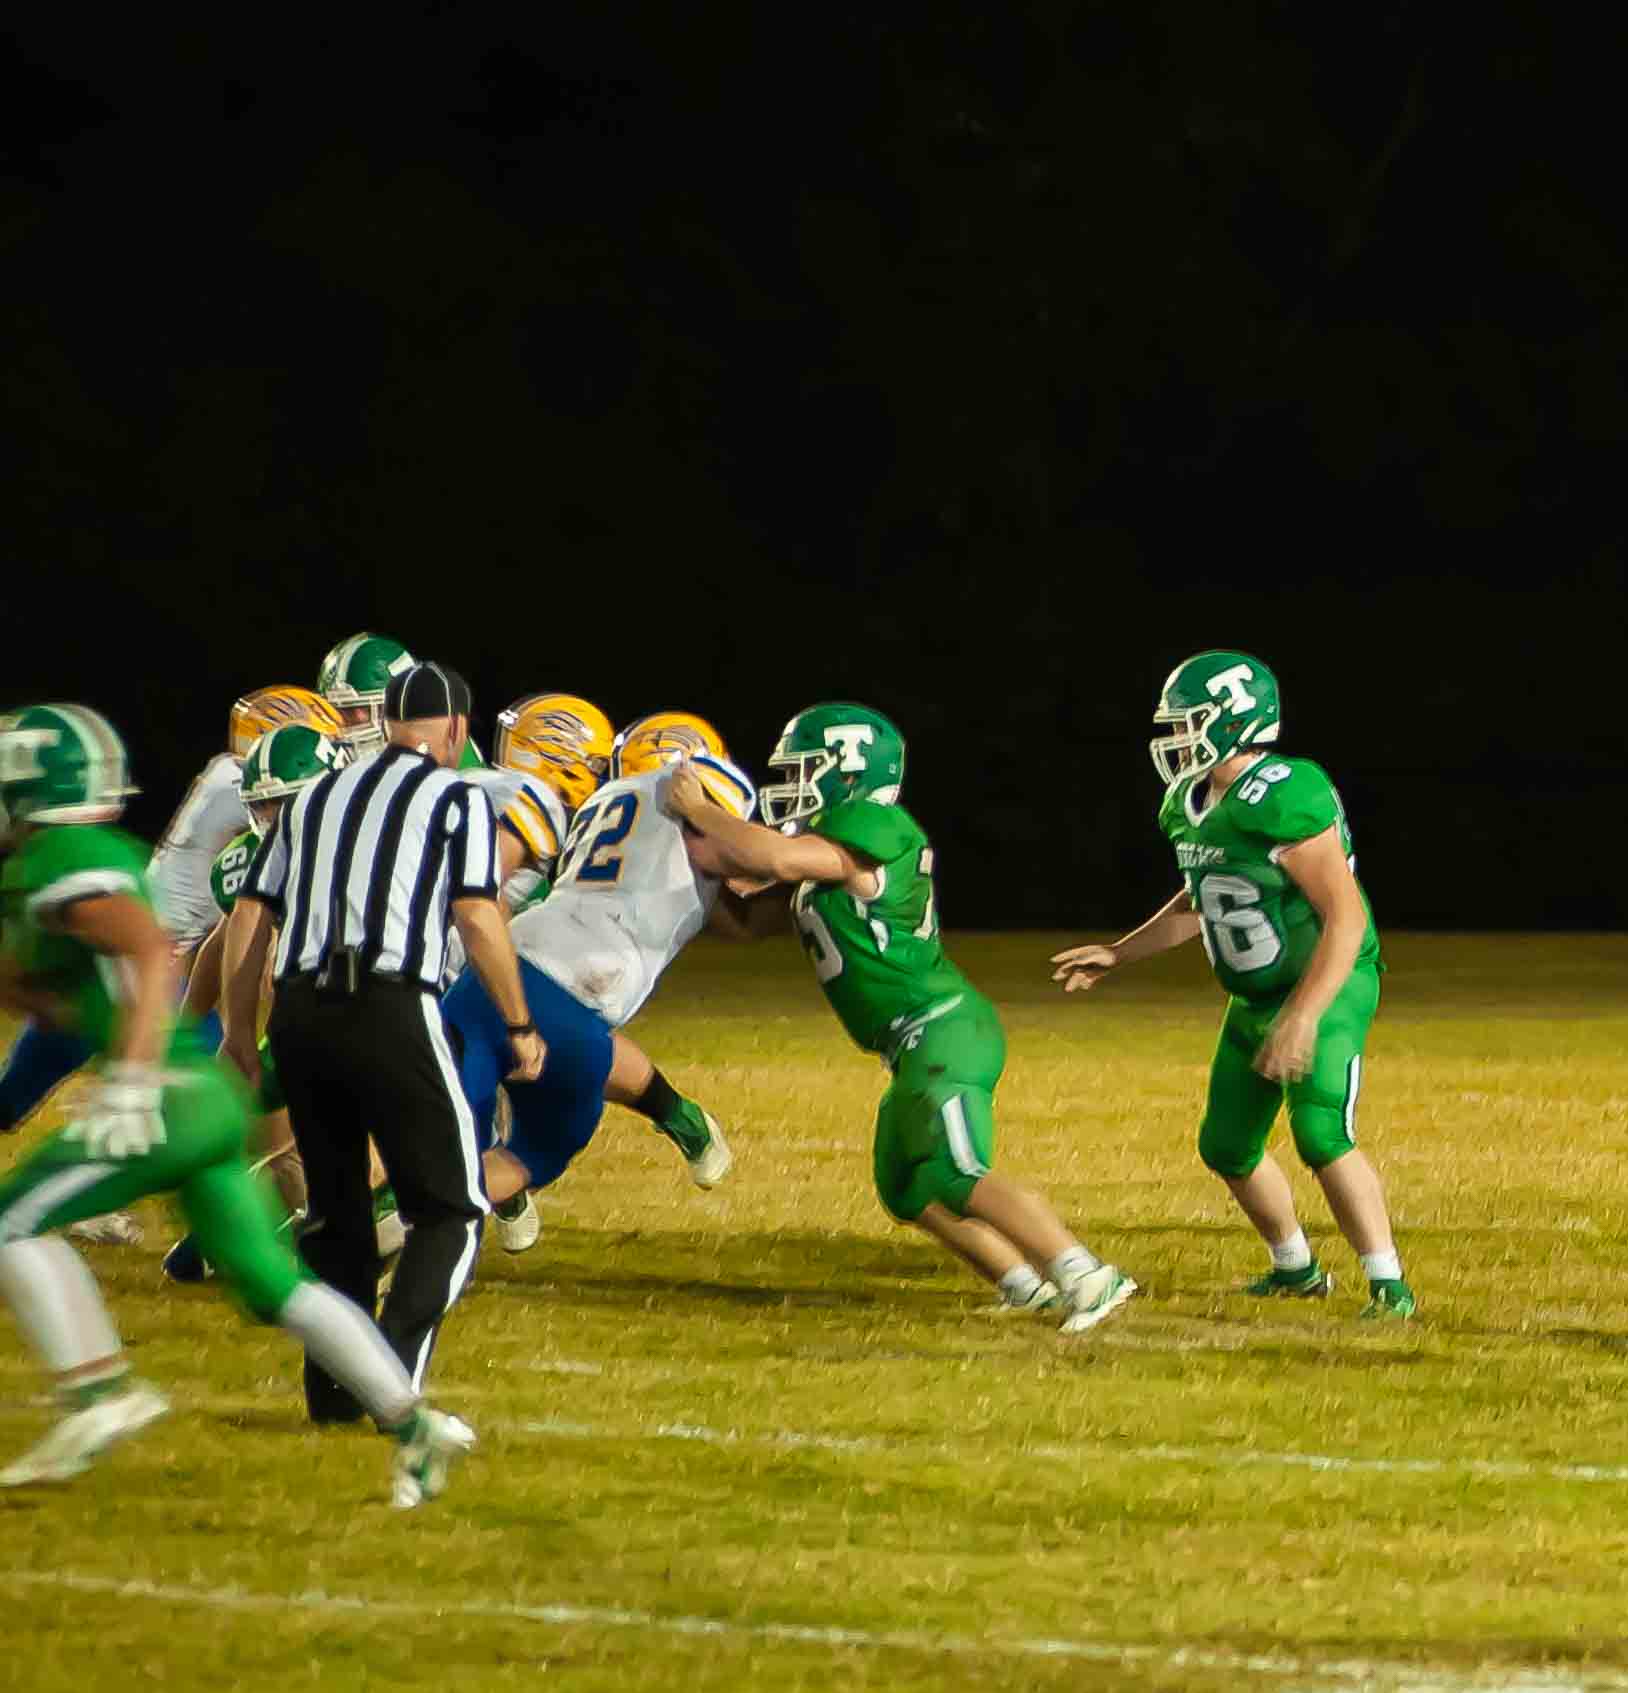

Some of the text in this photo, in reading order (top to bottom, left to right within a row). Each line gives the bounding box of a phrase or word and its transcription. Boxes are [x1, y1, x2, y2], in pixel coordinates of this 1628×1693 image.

[1206, 663, 1257, 715] T
[823, 724, 873, 772] T
[1187, 872, 1282, 973] 6
